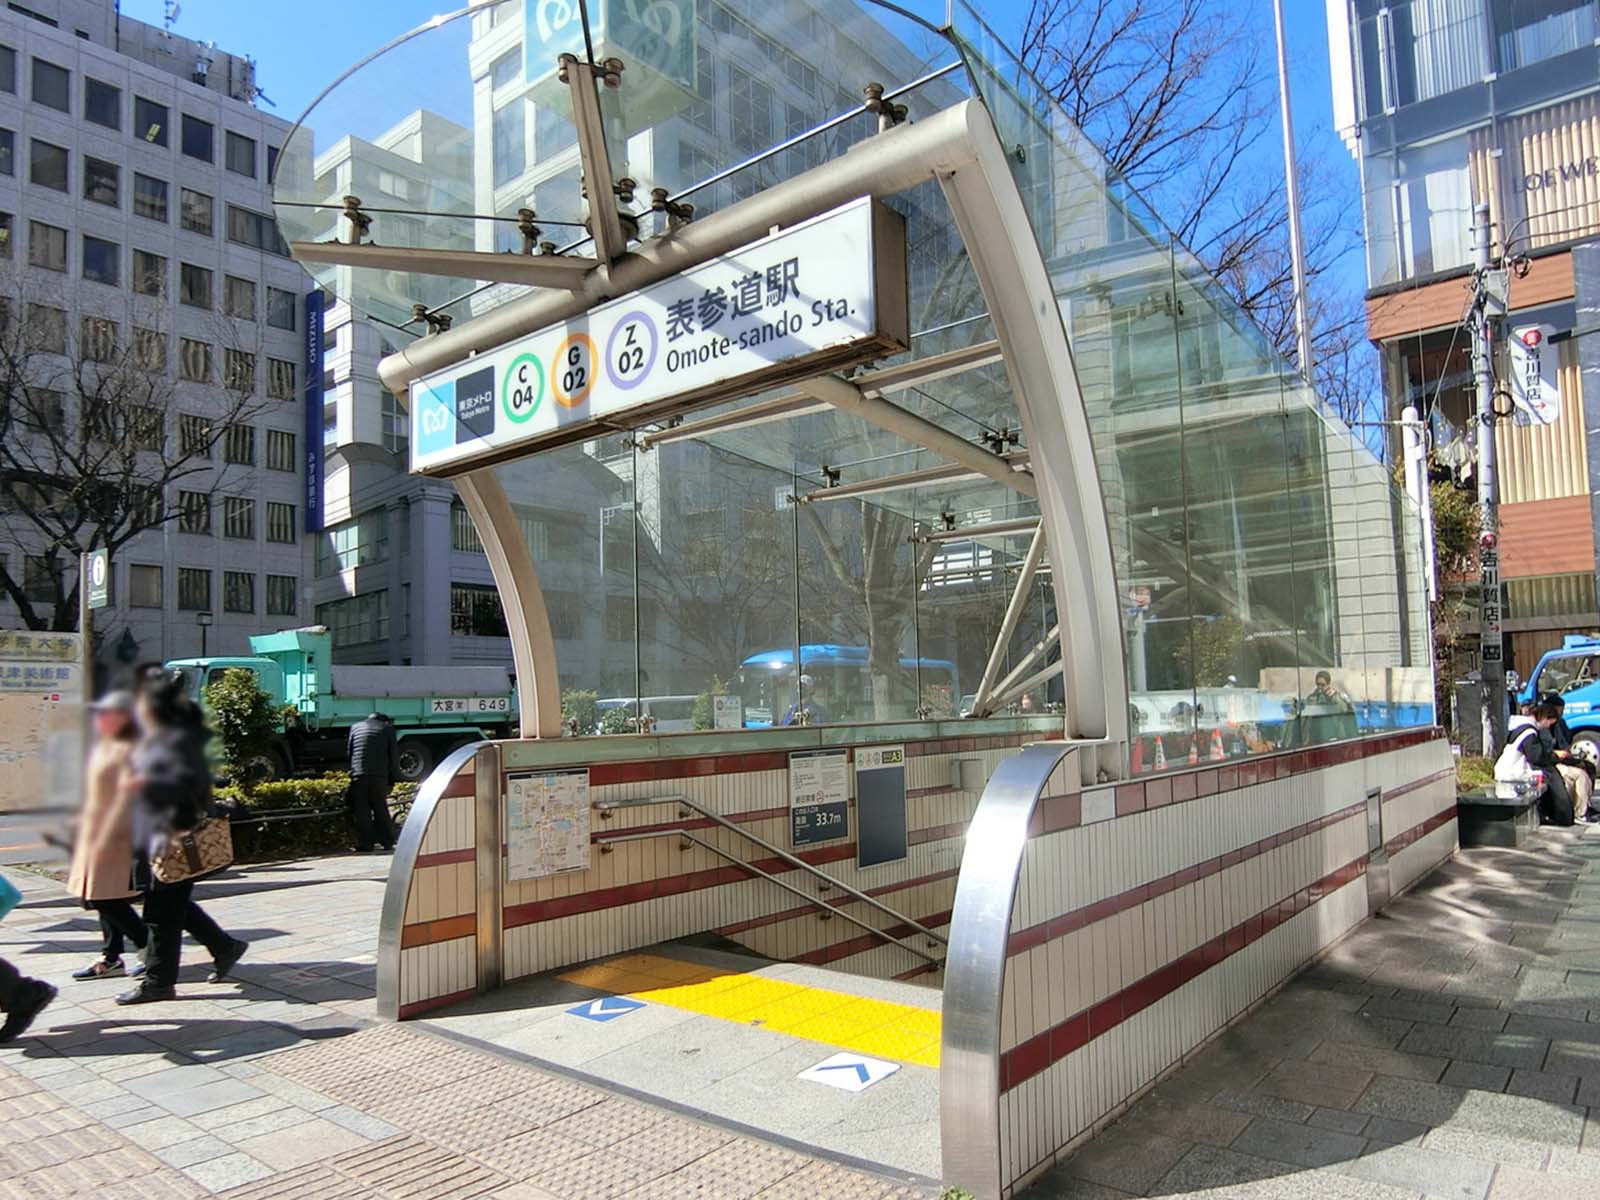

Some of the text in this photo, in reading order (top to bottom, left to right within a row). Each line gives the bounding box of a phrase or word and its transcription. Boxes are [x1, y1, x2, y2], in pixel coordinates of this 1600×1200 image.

[1512, 155, 1600, 194] LOEWE
[666, 257, 800, 343] 表参道駅
[309, 311, 317, 364] MIZUHO
[625, 324, 637, 347] Z
[666, 297, 856, 373] Omote-sando Sta.
[567, 345, 581, 367] G
[618, 347, 644, 374] 02
[518, 364, 528, 384] C
[563, 367, 586, 392] 02
[458, 391, 492, 412] 東京メトロ
[512, 386, 534, 409] 04
[1481, 551, 1499, 622] 吉川質店
[479, 699, 506, 711] 649
[891, 751, 902, 762] A3
[815, 812, 841, 826] 33.7m
